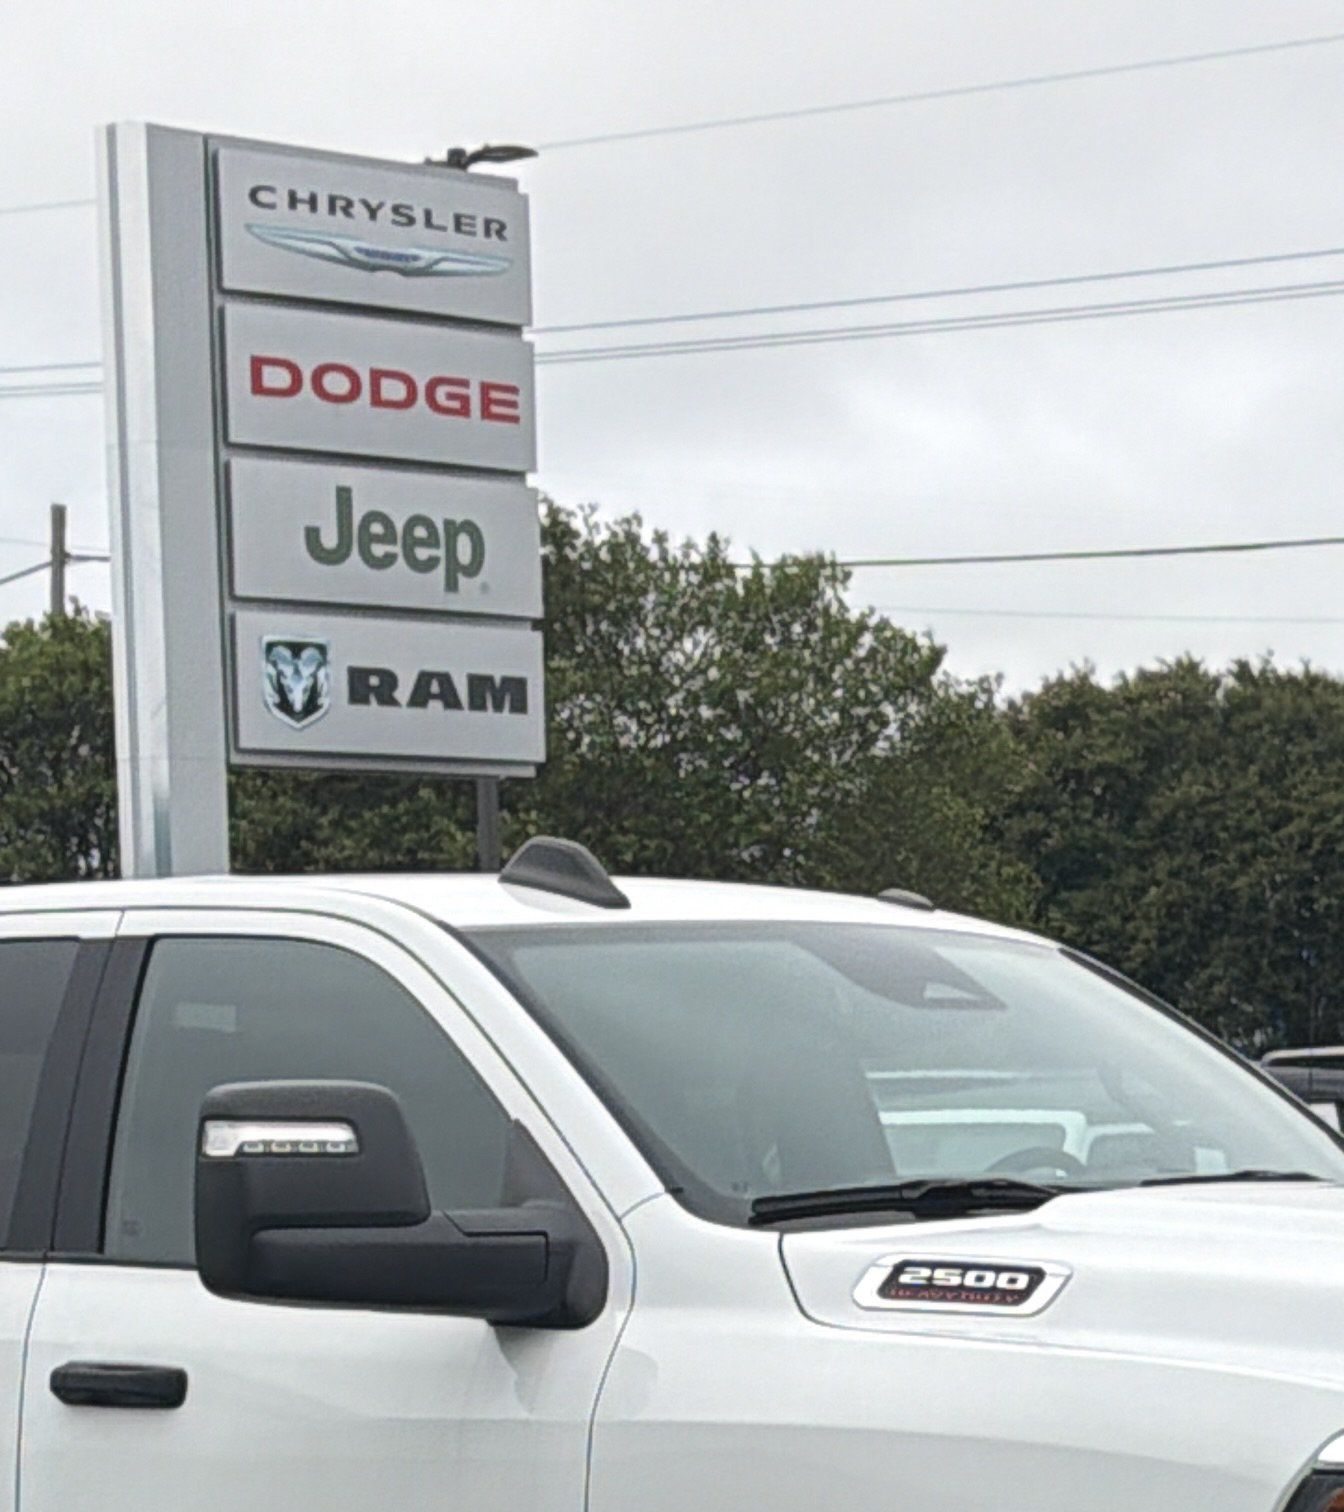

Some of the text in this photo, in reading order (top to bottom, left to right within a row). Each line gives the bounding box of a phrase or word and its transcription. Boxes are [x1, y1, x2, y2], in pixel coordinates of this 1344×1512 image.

[248, 184, 509, 242] CHRYSLER
[249, 354, 521, 424] DODGE
[304, 484, 486, 593] Jeep
[347, 665, 528, 715] RAM
[898, 1266, 1030, 1290] 2500
